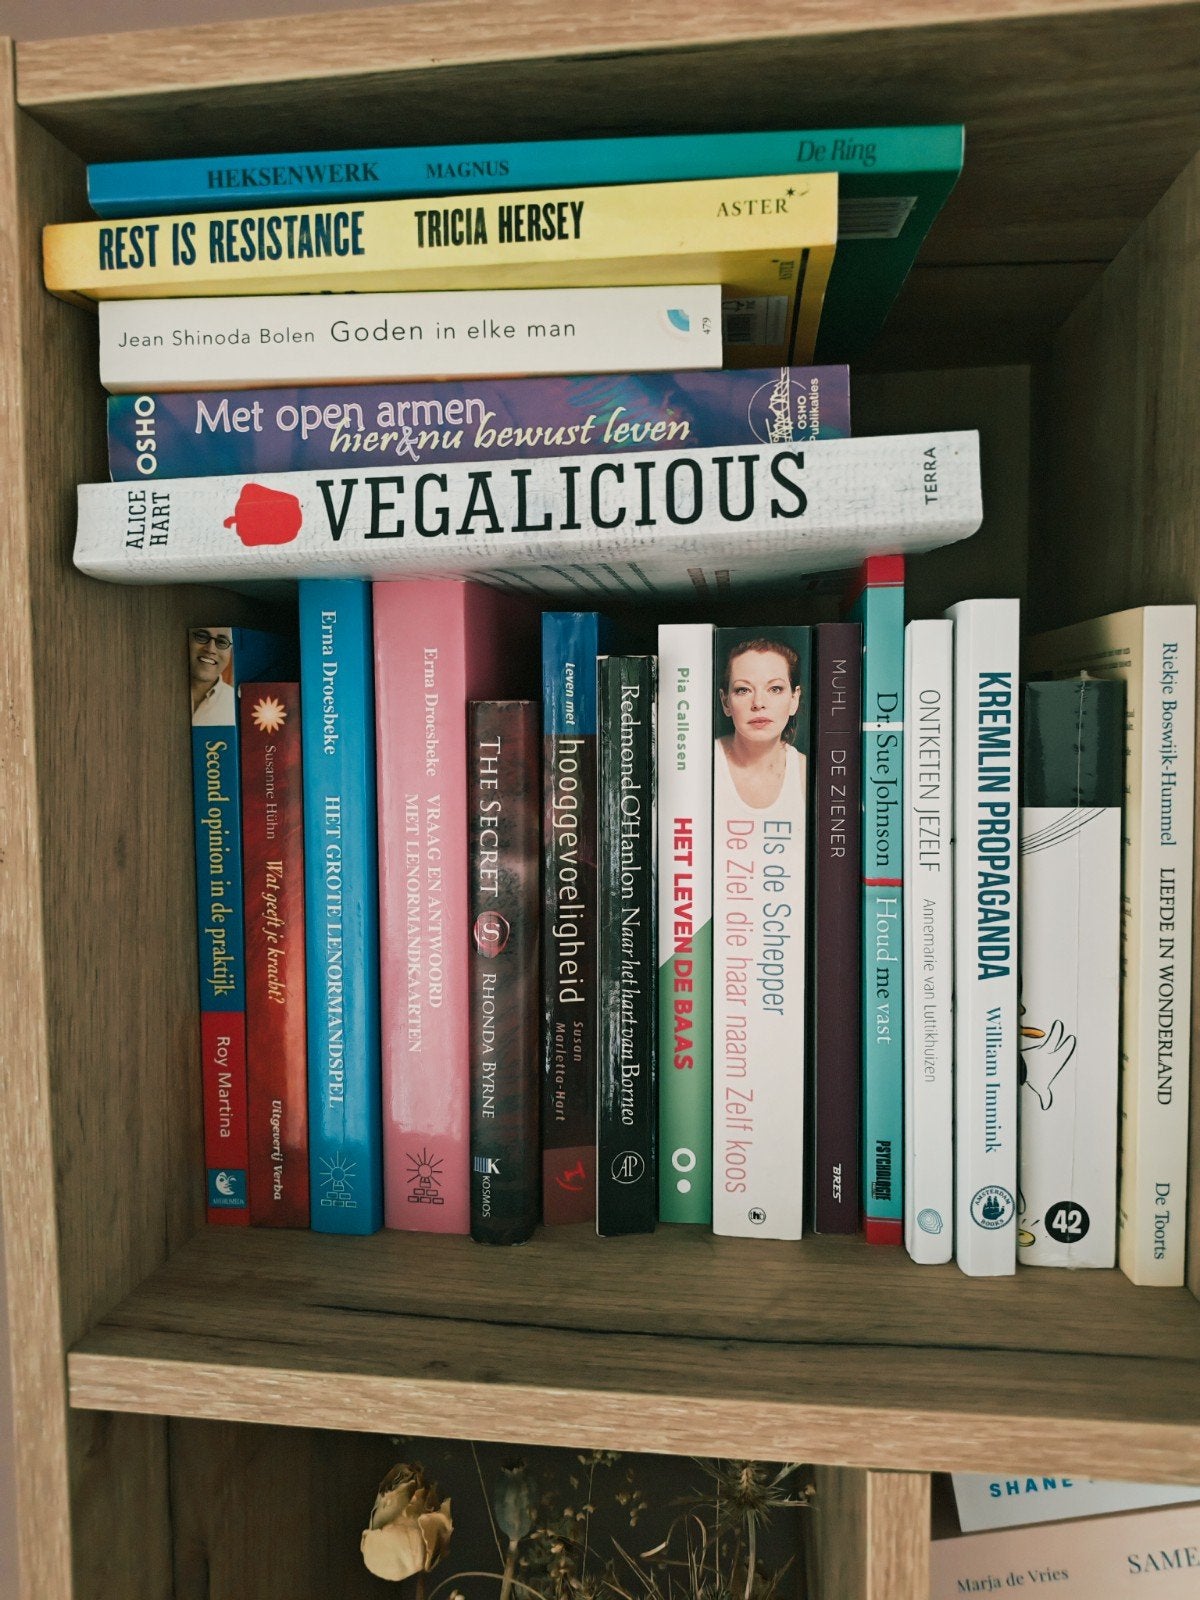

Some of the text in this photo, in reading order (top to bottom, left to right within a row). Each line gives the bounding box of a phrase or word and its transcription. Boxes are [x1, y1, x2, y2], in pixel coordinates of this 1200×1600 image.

[207, 161, 380, 190] HEKSENWERK
[425, 160, 510, 180] MAGNUS
[796, 139, 877, 167] De Ring
[99, 210, 365, 271] REST IS RESISTANCE
[414, 201, 584, 249] TRICIA HERSEY
[716, 198, 789, 218] ASTER
[118, 327, 315, 349] Jean Shinoda Bolen
[330, 319, 576, 343] Goden in elke man
[702, 317, 711, 335] 479
[134, 395, 158, 475] OSHO
[195, 397, 485, 440] Met open armen
[473, 411, 596, 449] bewust
[604, 406, 690, 444] leven
[797, 395, 807, 430] OSHO
[126, 489, 147, 549] ALICE
[149, 491, 171, 546] HART
[316, 451, 808, 541] VEGALICIOUS
[924, 446, 937, 506] TERRA
[321, 610, 340, 756] Erna Droesbeke
[424, 648, 441, 777] Erna Droesbeke
[565, 662, 576, 726] Leven met
[677, 667, 689, 771] Pia Callesen
[265, 744, 278, 840] Susanne Hühn
[620, 684, 641, 900] Redmond O'Hanlon
[830, 659, 847, 858] MUHL DE ZIENER
[871, 692, 899, 867] Dr. Sue Johnson
[914, 690, 941, 872] ONTKETEN JEZELF
[1159, 642, 1178, 846] Riekje Boswijk-Hummel
[479, 736, 501, 897] THE SECRET
[977, 672, 1011, 981] KREMLIN PROPAGANDA
[201, 741, 236, 997] Second opinion in de praktijk
[426, 794, 443, 1009] VRAAG EN ANTWOORD
[553, 740, 585, 1003] hooggevoeligheid
[757, 820, 791, 1015] Els de Schepper
[261, 859, 287, 1005] Wat geeft je kracht?
[325, 796, 344, 1108] HET GROTE LENORMANDSPEL
[405, 794, 422, 1052] MET LENORMANDKAARTEN
[673, 818, 694, 1070] HET LEVEN DE BAAS
[876, 897, 898, 1044] Houd me vast
[621, 907, 640, 1126] Naar het hart van Borneo
[725, 820, 754, 1193] De Ziel die haar naam Zelf koos
[923, 899, 939, 1083] Annemarie van Luttikhuizen
[1157, 867, 1175, 1105] LIEFDE IN WONDERLAND
[213, 1036, 232, 1138] Roy Martina
[481, 973, 497, 1119] RHONDA BYRNE
[555, 1023, 566, 1122] Marletta-Hart
[573, 1020, 584, 1062] Susan
[985, 1007, 1003, 1153] William Immink
[270, 1099, 283, 1201] Uitgeverij Verba
[482, 1175, 491, 1218] KOSMOS
[832, 1163, 842, 1203] BRES
[875, 1140, 892, 1201] PSYCHOLOGIE
[974, 1189, 1011, 1226] AMSTERDAM BOOKS
[1052, 1209, 1082, 1234] 42
[1154, 1182, 1170, 1260] De Toorts
[957, 1568, 1069, 1593] Marja de Vries
